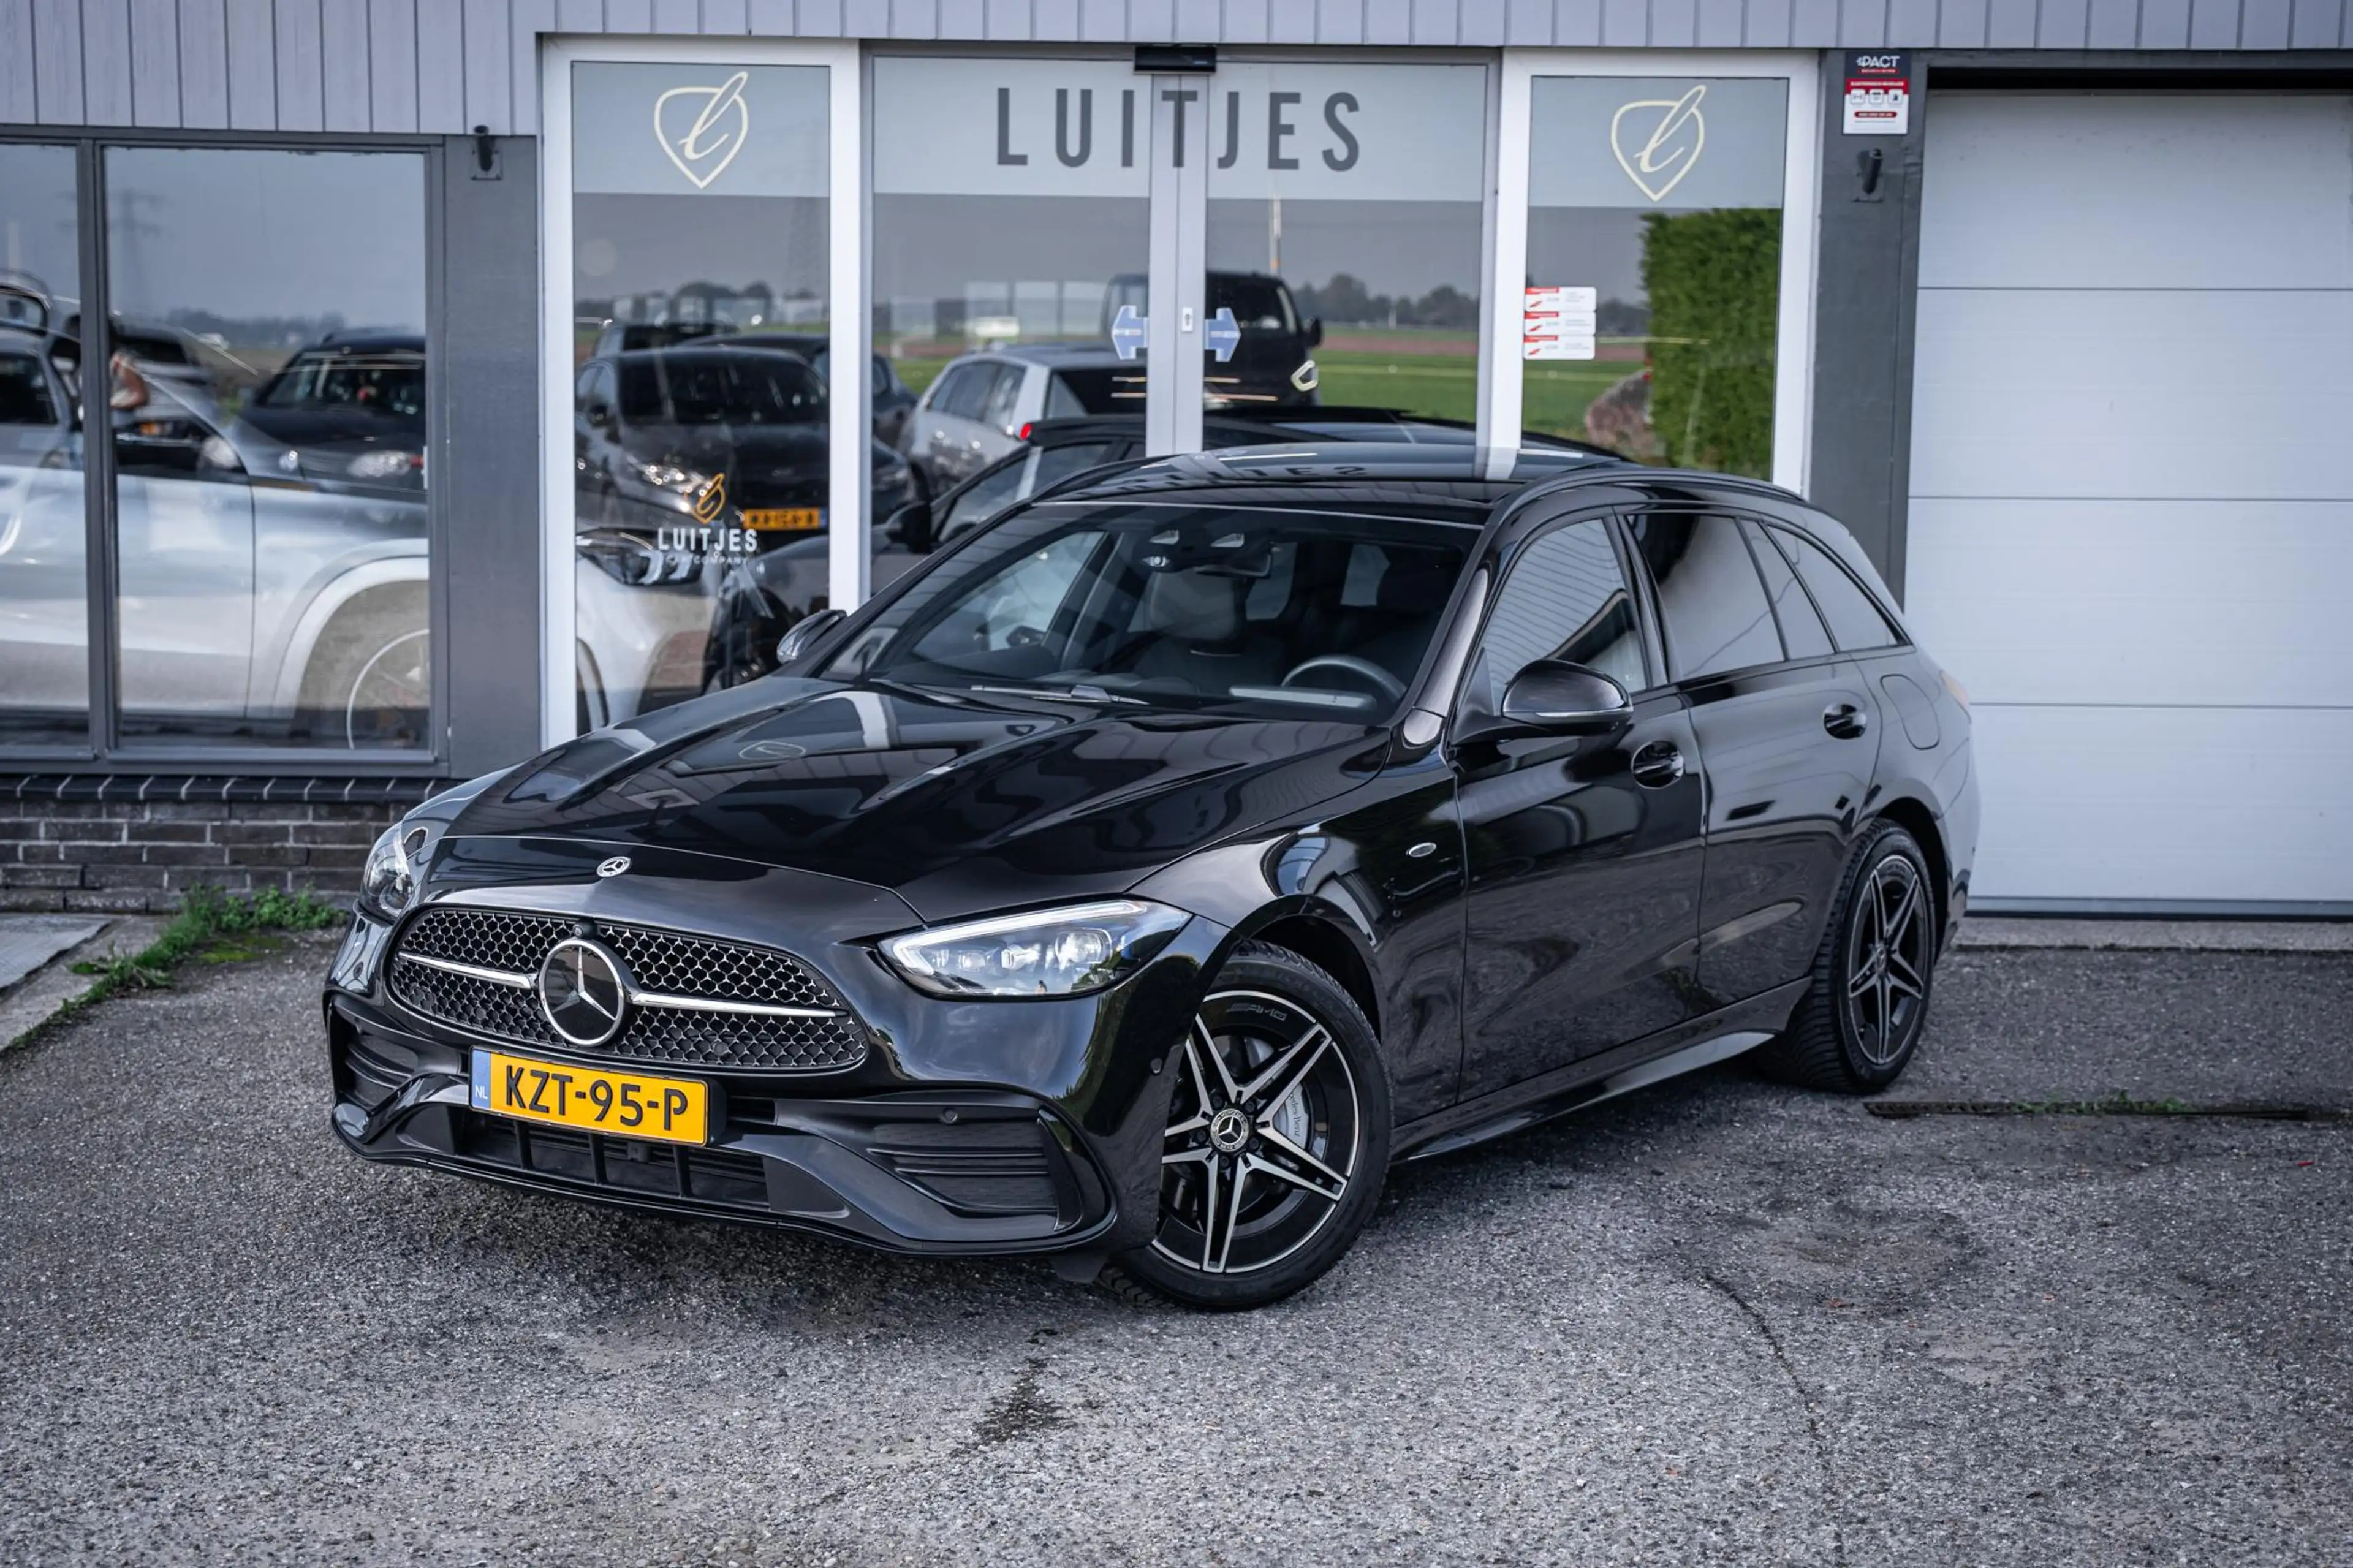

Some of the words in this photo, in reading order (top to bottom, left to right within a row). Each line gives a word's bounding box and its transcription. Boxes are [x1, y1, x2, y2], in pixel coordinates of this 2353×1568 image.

[996, 88, 1360, 172] LUITJES
[657, 528, 757, 553] LUITJES
[475, 1085, 488, 1100] NL
[506, 1064, 688, 1131] KZT-95-P
